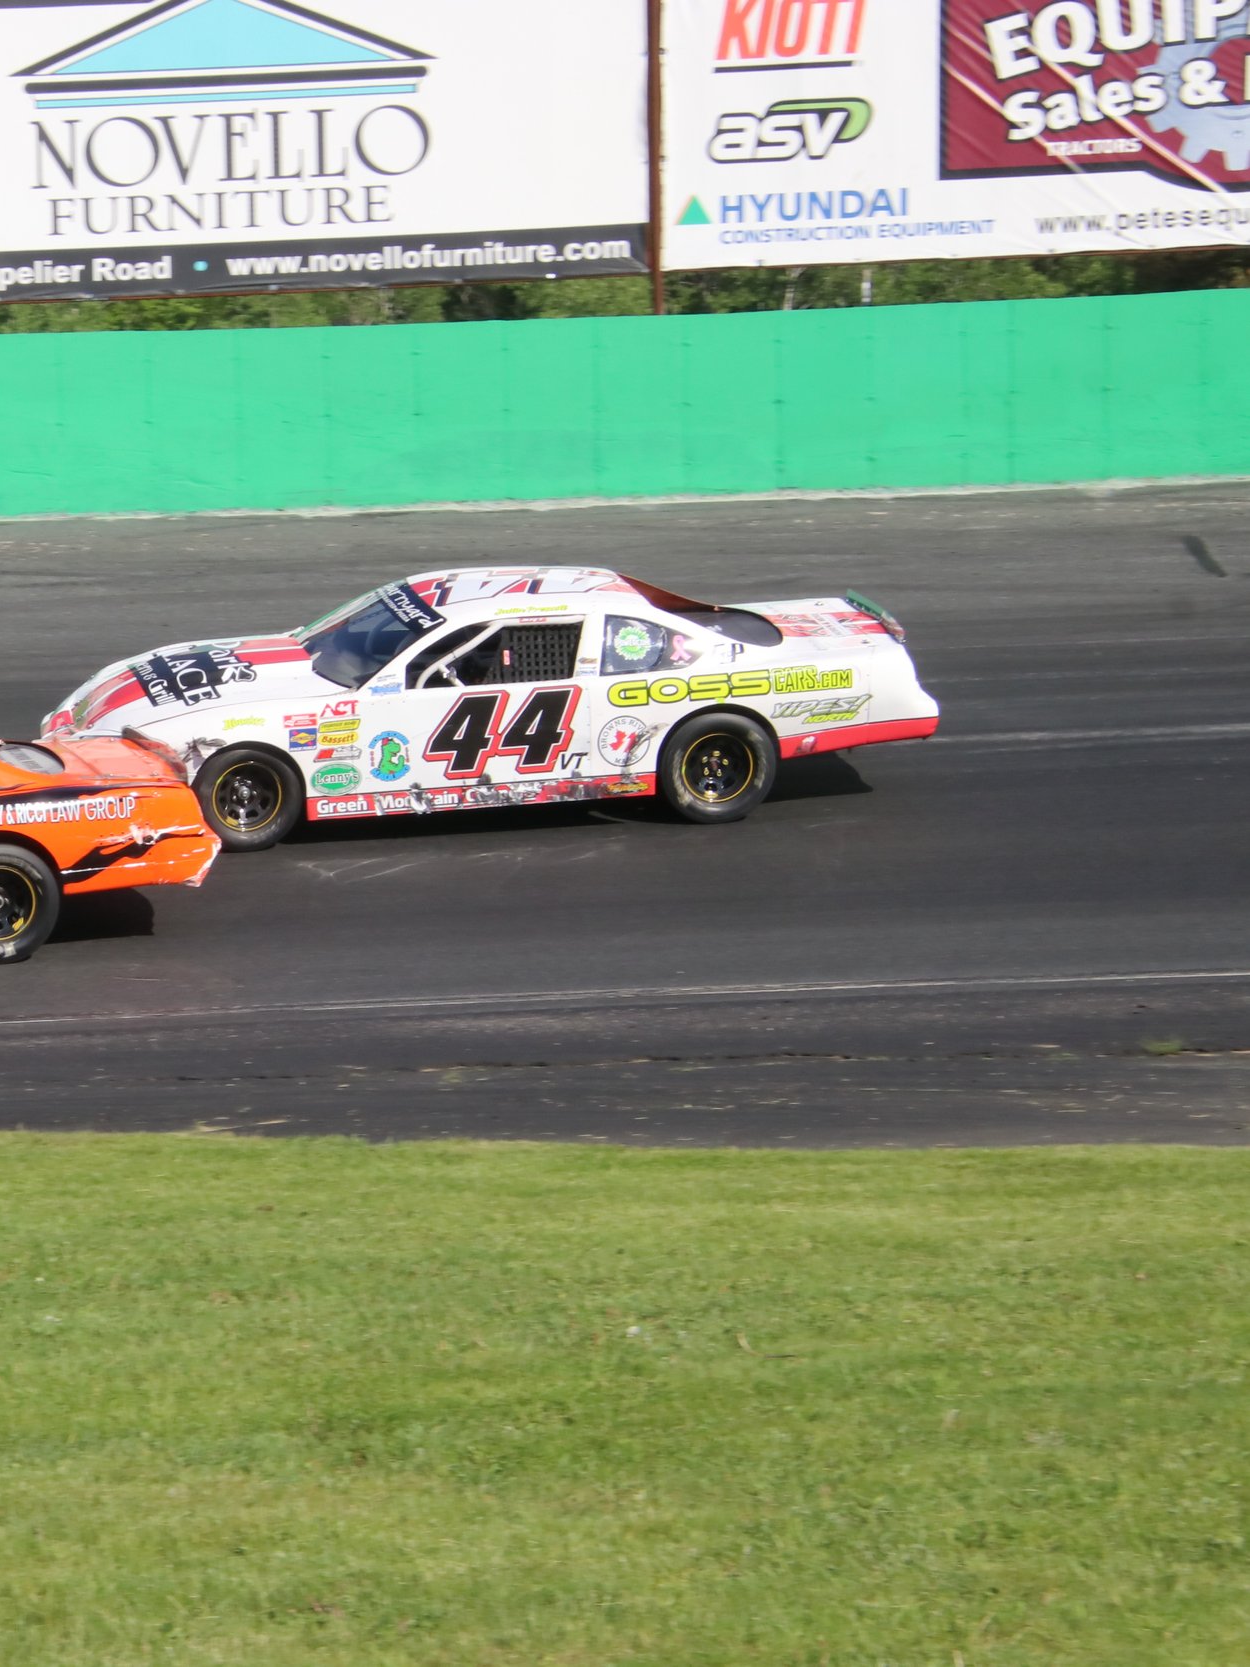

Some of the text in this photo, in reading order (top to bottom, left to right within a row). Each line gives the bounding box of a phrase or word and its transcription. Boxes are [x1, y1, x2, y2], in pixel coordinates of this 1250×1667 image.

[715, 0, 867, 60] KIOTI
[984, 0, 1250, 79] EQUIP
[1003, 58, 1230, 140] Sales &
[29, 104, 431, 190] NOVELLO
[47, 185, 396, 236] FURNITURE
[719, 188, 909, 223] HYUNDAI
[719, 218, 996, 245] CONSTRUCTION EQUIPMENT
[91, 255, 173, 282] Road
[225, 240, 631, 276] www.novellofurniture.com
[607, 668, 770, 708] GOSS
[424, 685, 583, 780] 44
[315, 772, 360, 785] Lenny's
[561, 752, 589, 770] VT
[6, 802, 15, 825] &
[50, 799, 81, 822] LAW
[83, 796, 136, 821] GROUP
[317, 792, 368, 814] Green
[379, 790, 459, 811] Motain
